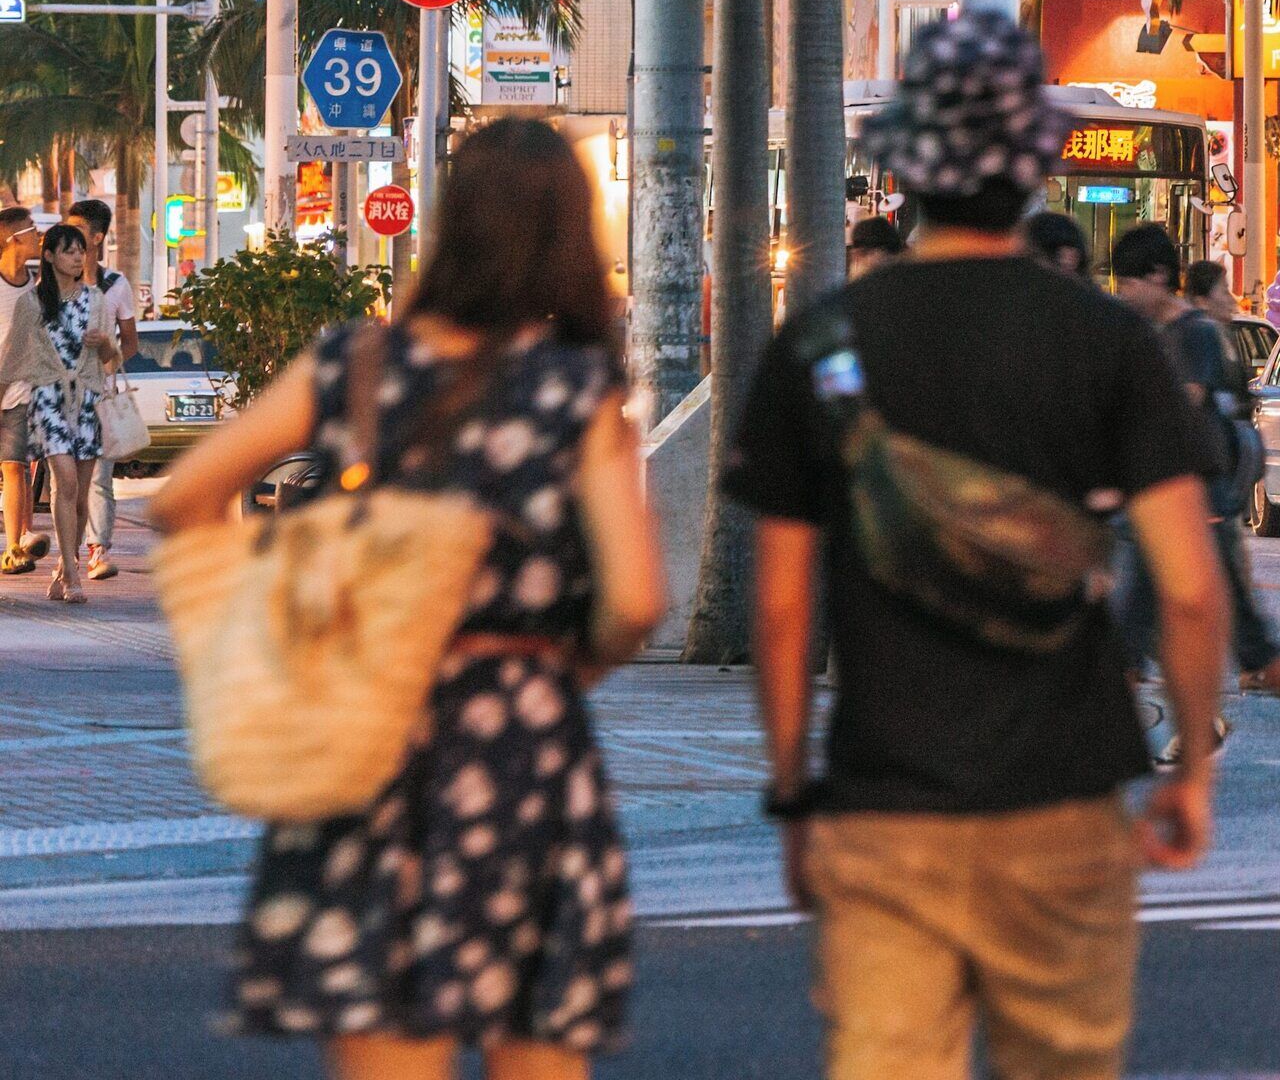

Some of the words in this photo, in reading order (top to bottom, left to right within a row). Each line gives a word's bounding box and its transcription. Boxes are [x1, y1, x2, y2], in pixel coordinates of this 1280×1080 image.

[334, 37, 374, 52] 県道
[324, 57, 382, 97] 39
[328, 103, 377, 119] 沖縄
[368, 200, 410, 220] 消火栓
[183, 404, 214, 416] 60-23
